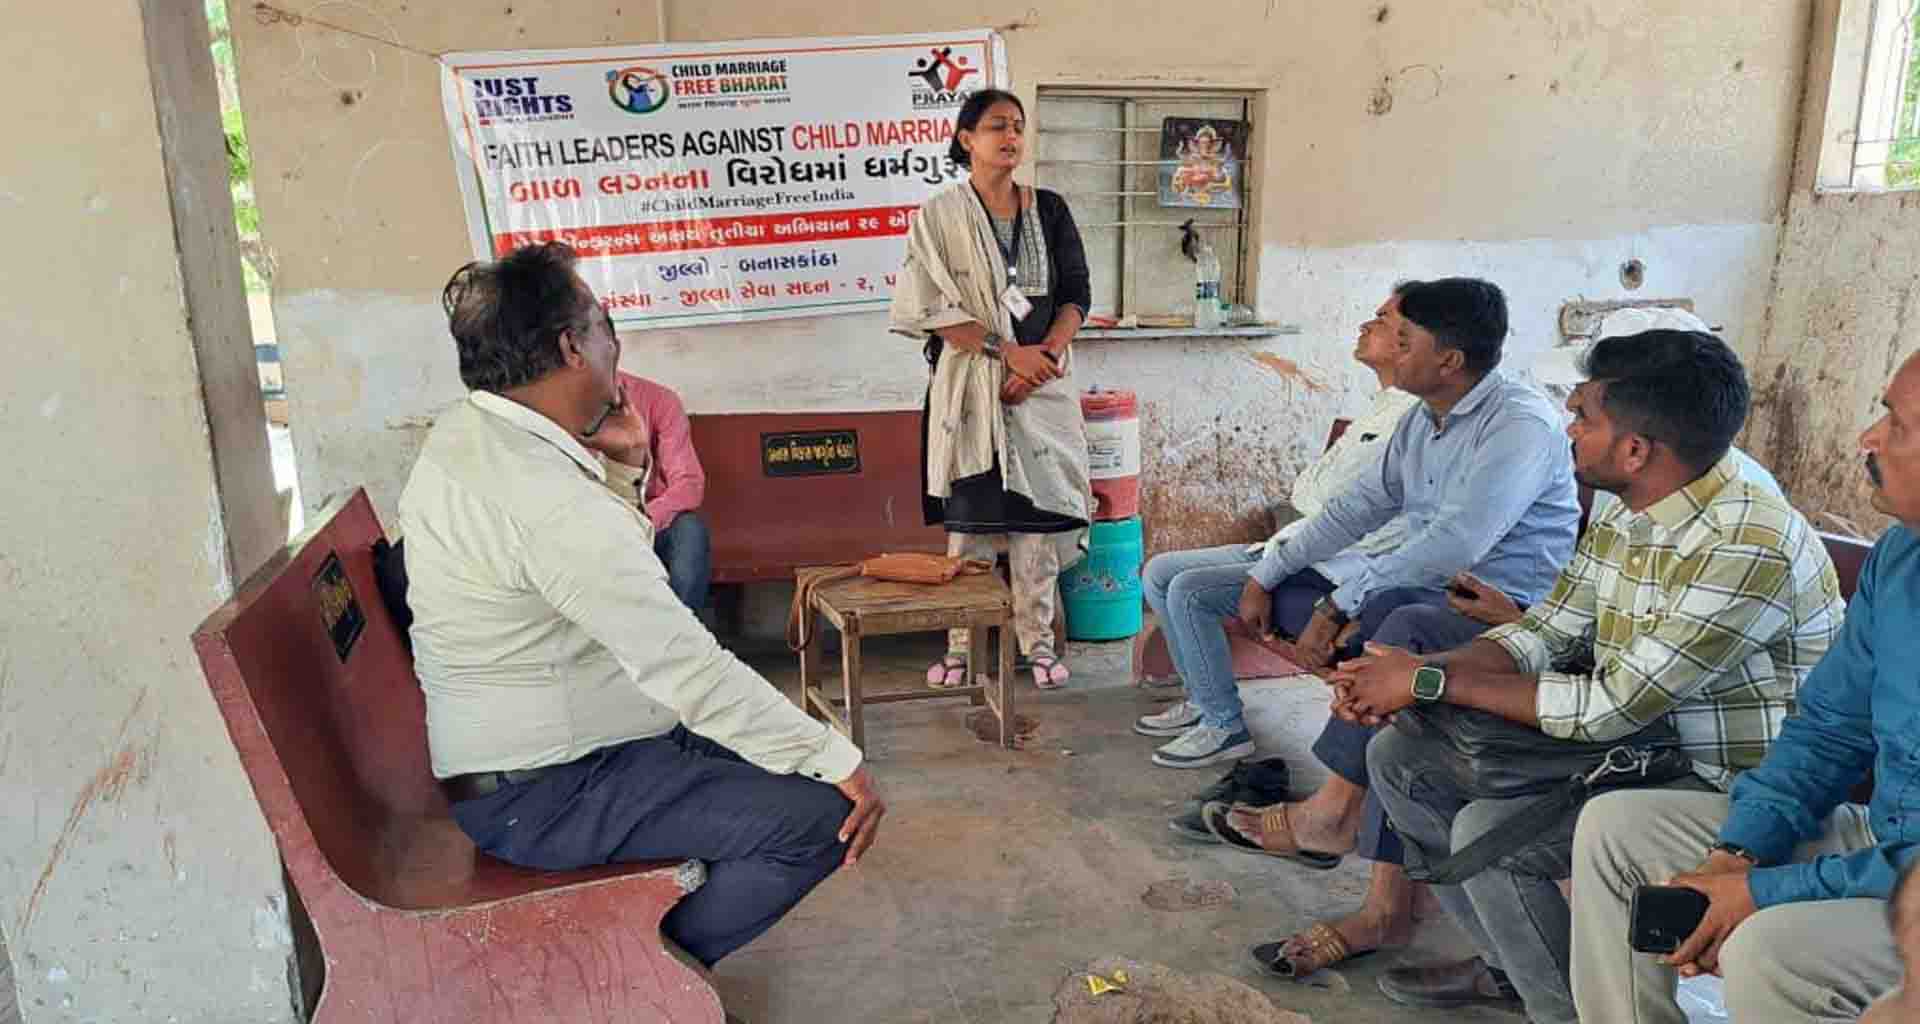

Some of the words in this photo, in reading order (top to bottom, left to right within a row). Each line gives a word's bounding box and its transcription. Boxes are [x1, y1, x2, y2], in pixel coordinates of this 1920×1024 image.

[671, 63, 712, 78] CHILD
[716, 59, 788, 75] MARRIAGE
[673, 78, 716, 95] FREE
[719, 75, 788, 93] BHARAT
[483, 140, 554, 169] FAITH
[559, 132, 675, 165] LEADERS
[682, 126, 785, 157] AGAINST
[791, 121, 861, 151] CHILD
[866, 117, 954, 145] MARRIA
[726, 153, 848, 188] વિરોધમાં
[641, 188, 856, 213] #ChildMarriageFreeIndia
[738, 248, 838, 273] બનાસકાંઠા
[785, 279, 831, 297] સદન
